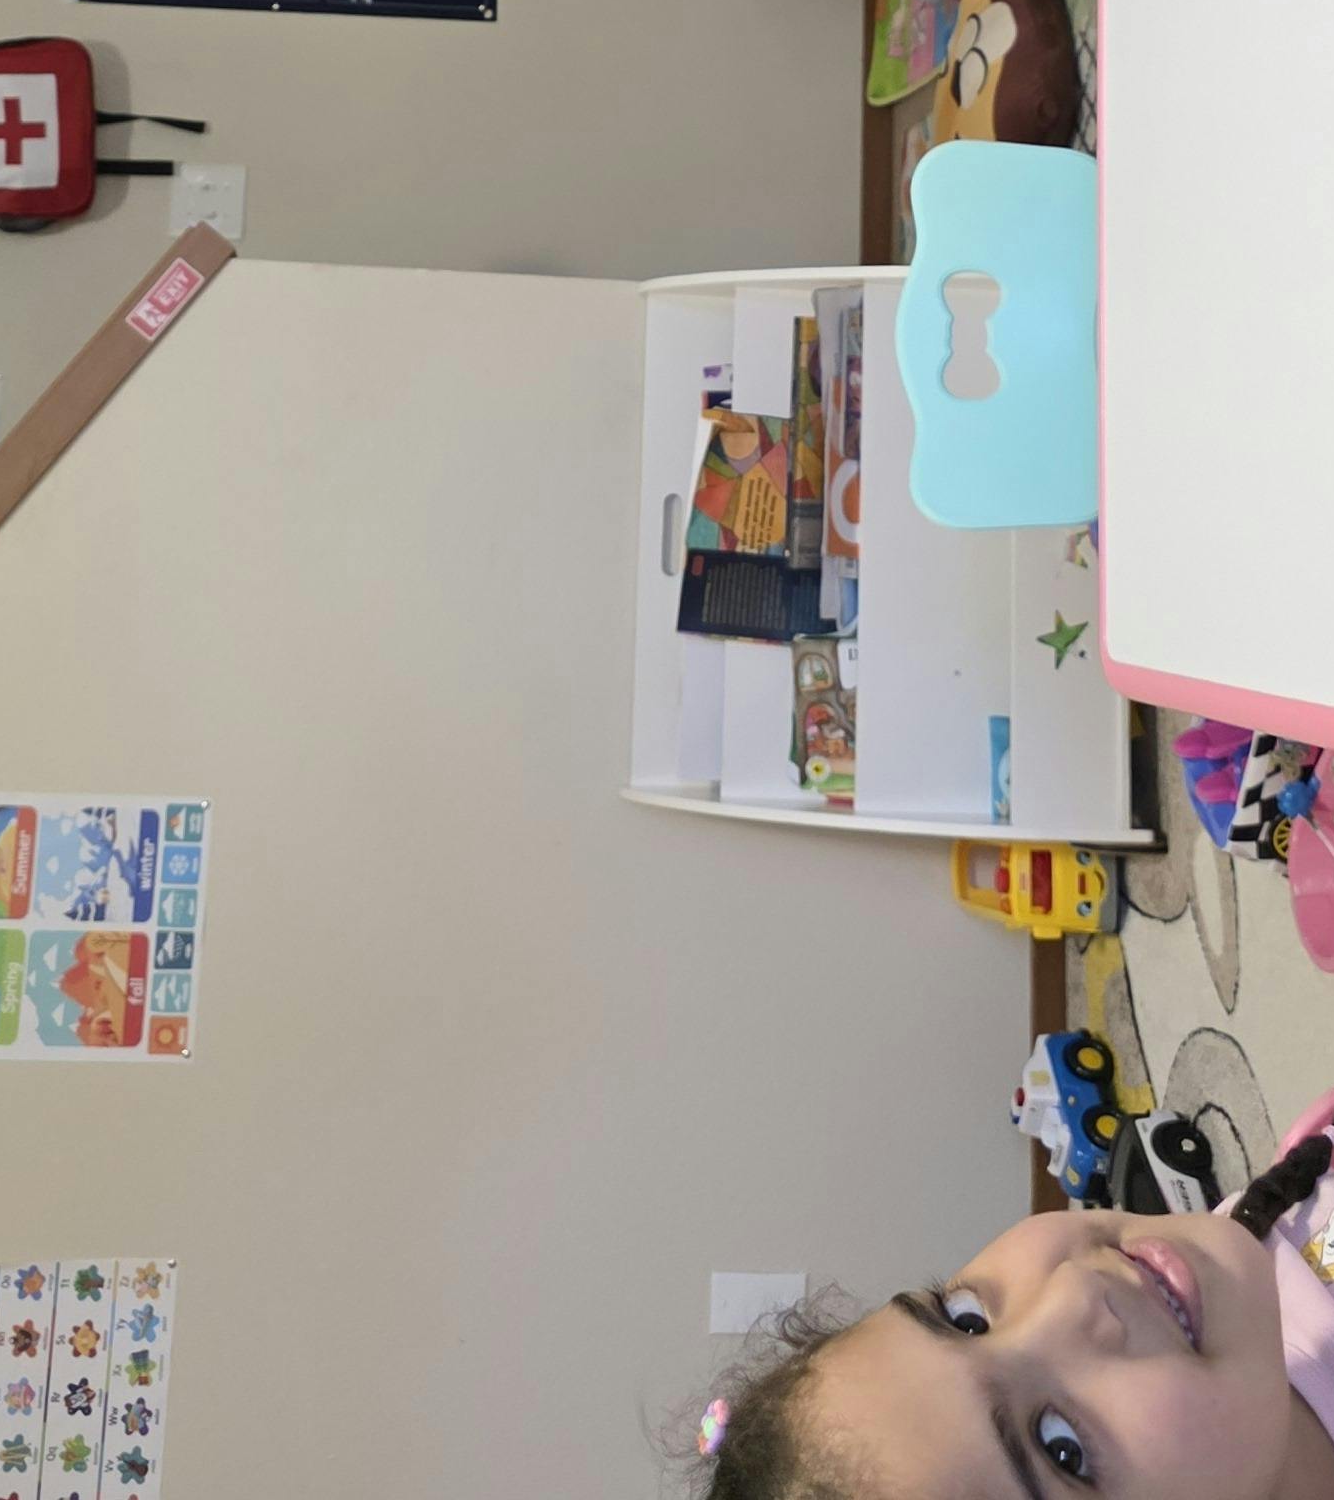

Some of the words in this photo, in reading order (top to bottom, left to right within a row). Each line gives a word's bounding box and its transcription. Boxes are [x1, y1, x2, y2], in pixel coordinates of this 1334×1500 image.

[11, 828, 32, 894] Summer
[139, 836, 155, 888] winter
[0, 960, 24, 1012] Spring
[127, 976, 144, 1004] fall
